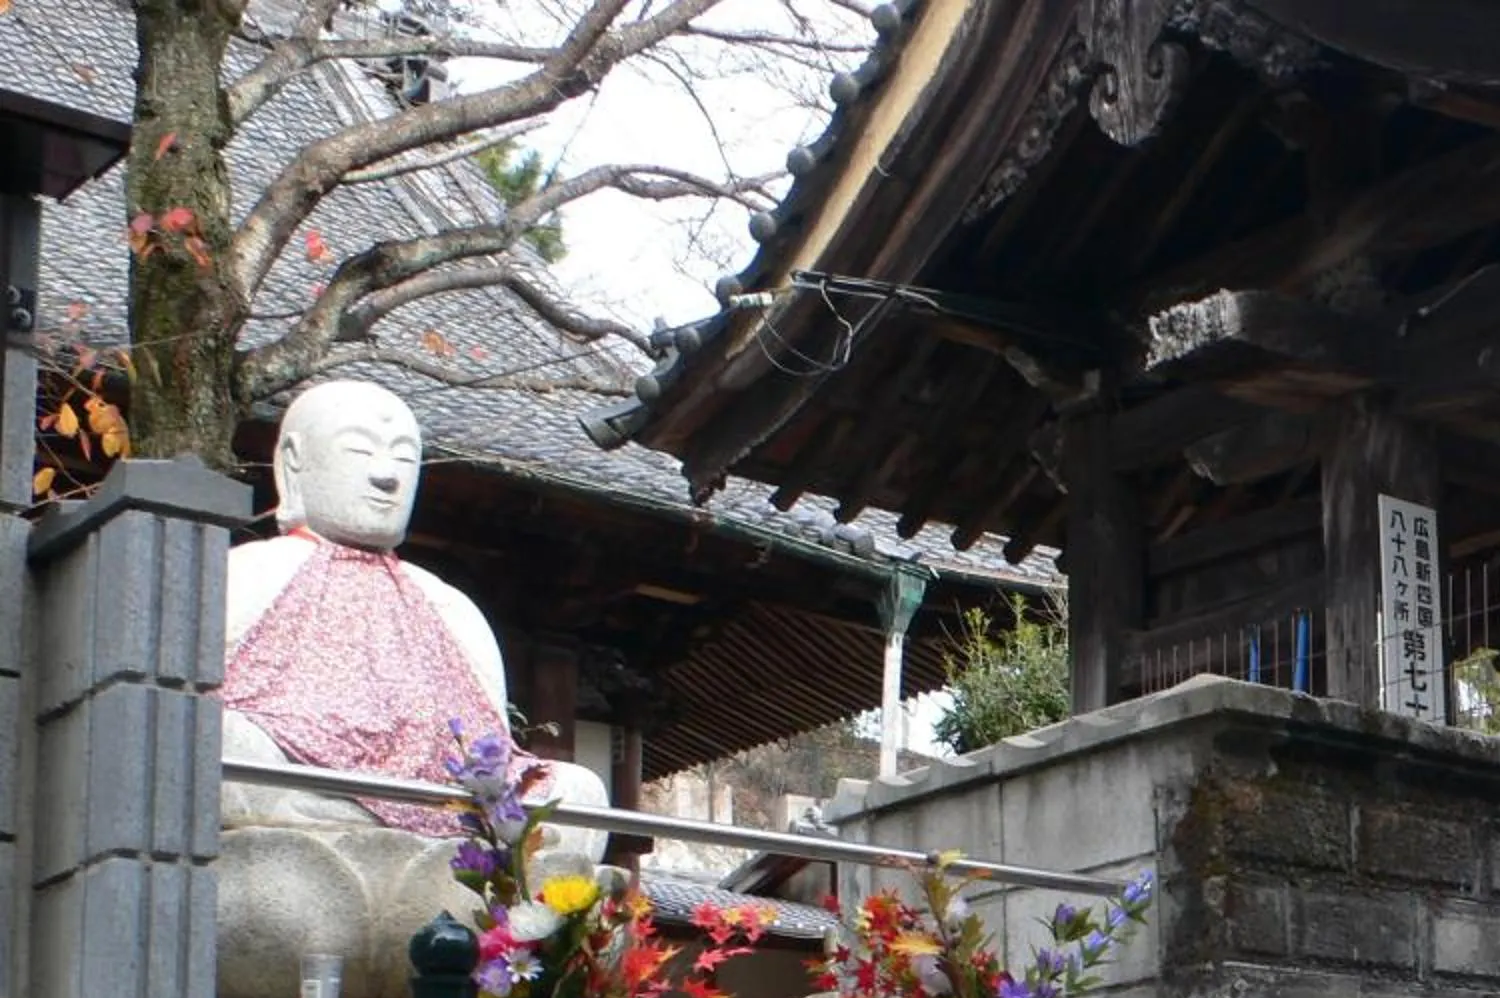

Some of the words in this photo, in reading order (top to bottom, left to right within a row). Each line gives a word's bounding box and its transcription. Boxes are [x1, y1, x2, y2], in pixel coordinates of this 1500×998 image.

[1413, 517, 1433, 628] 広島新四国
[1403, 629, 1428, 718] 第七十
